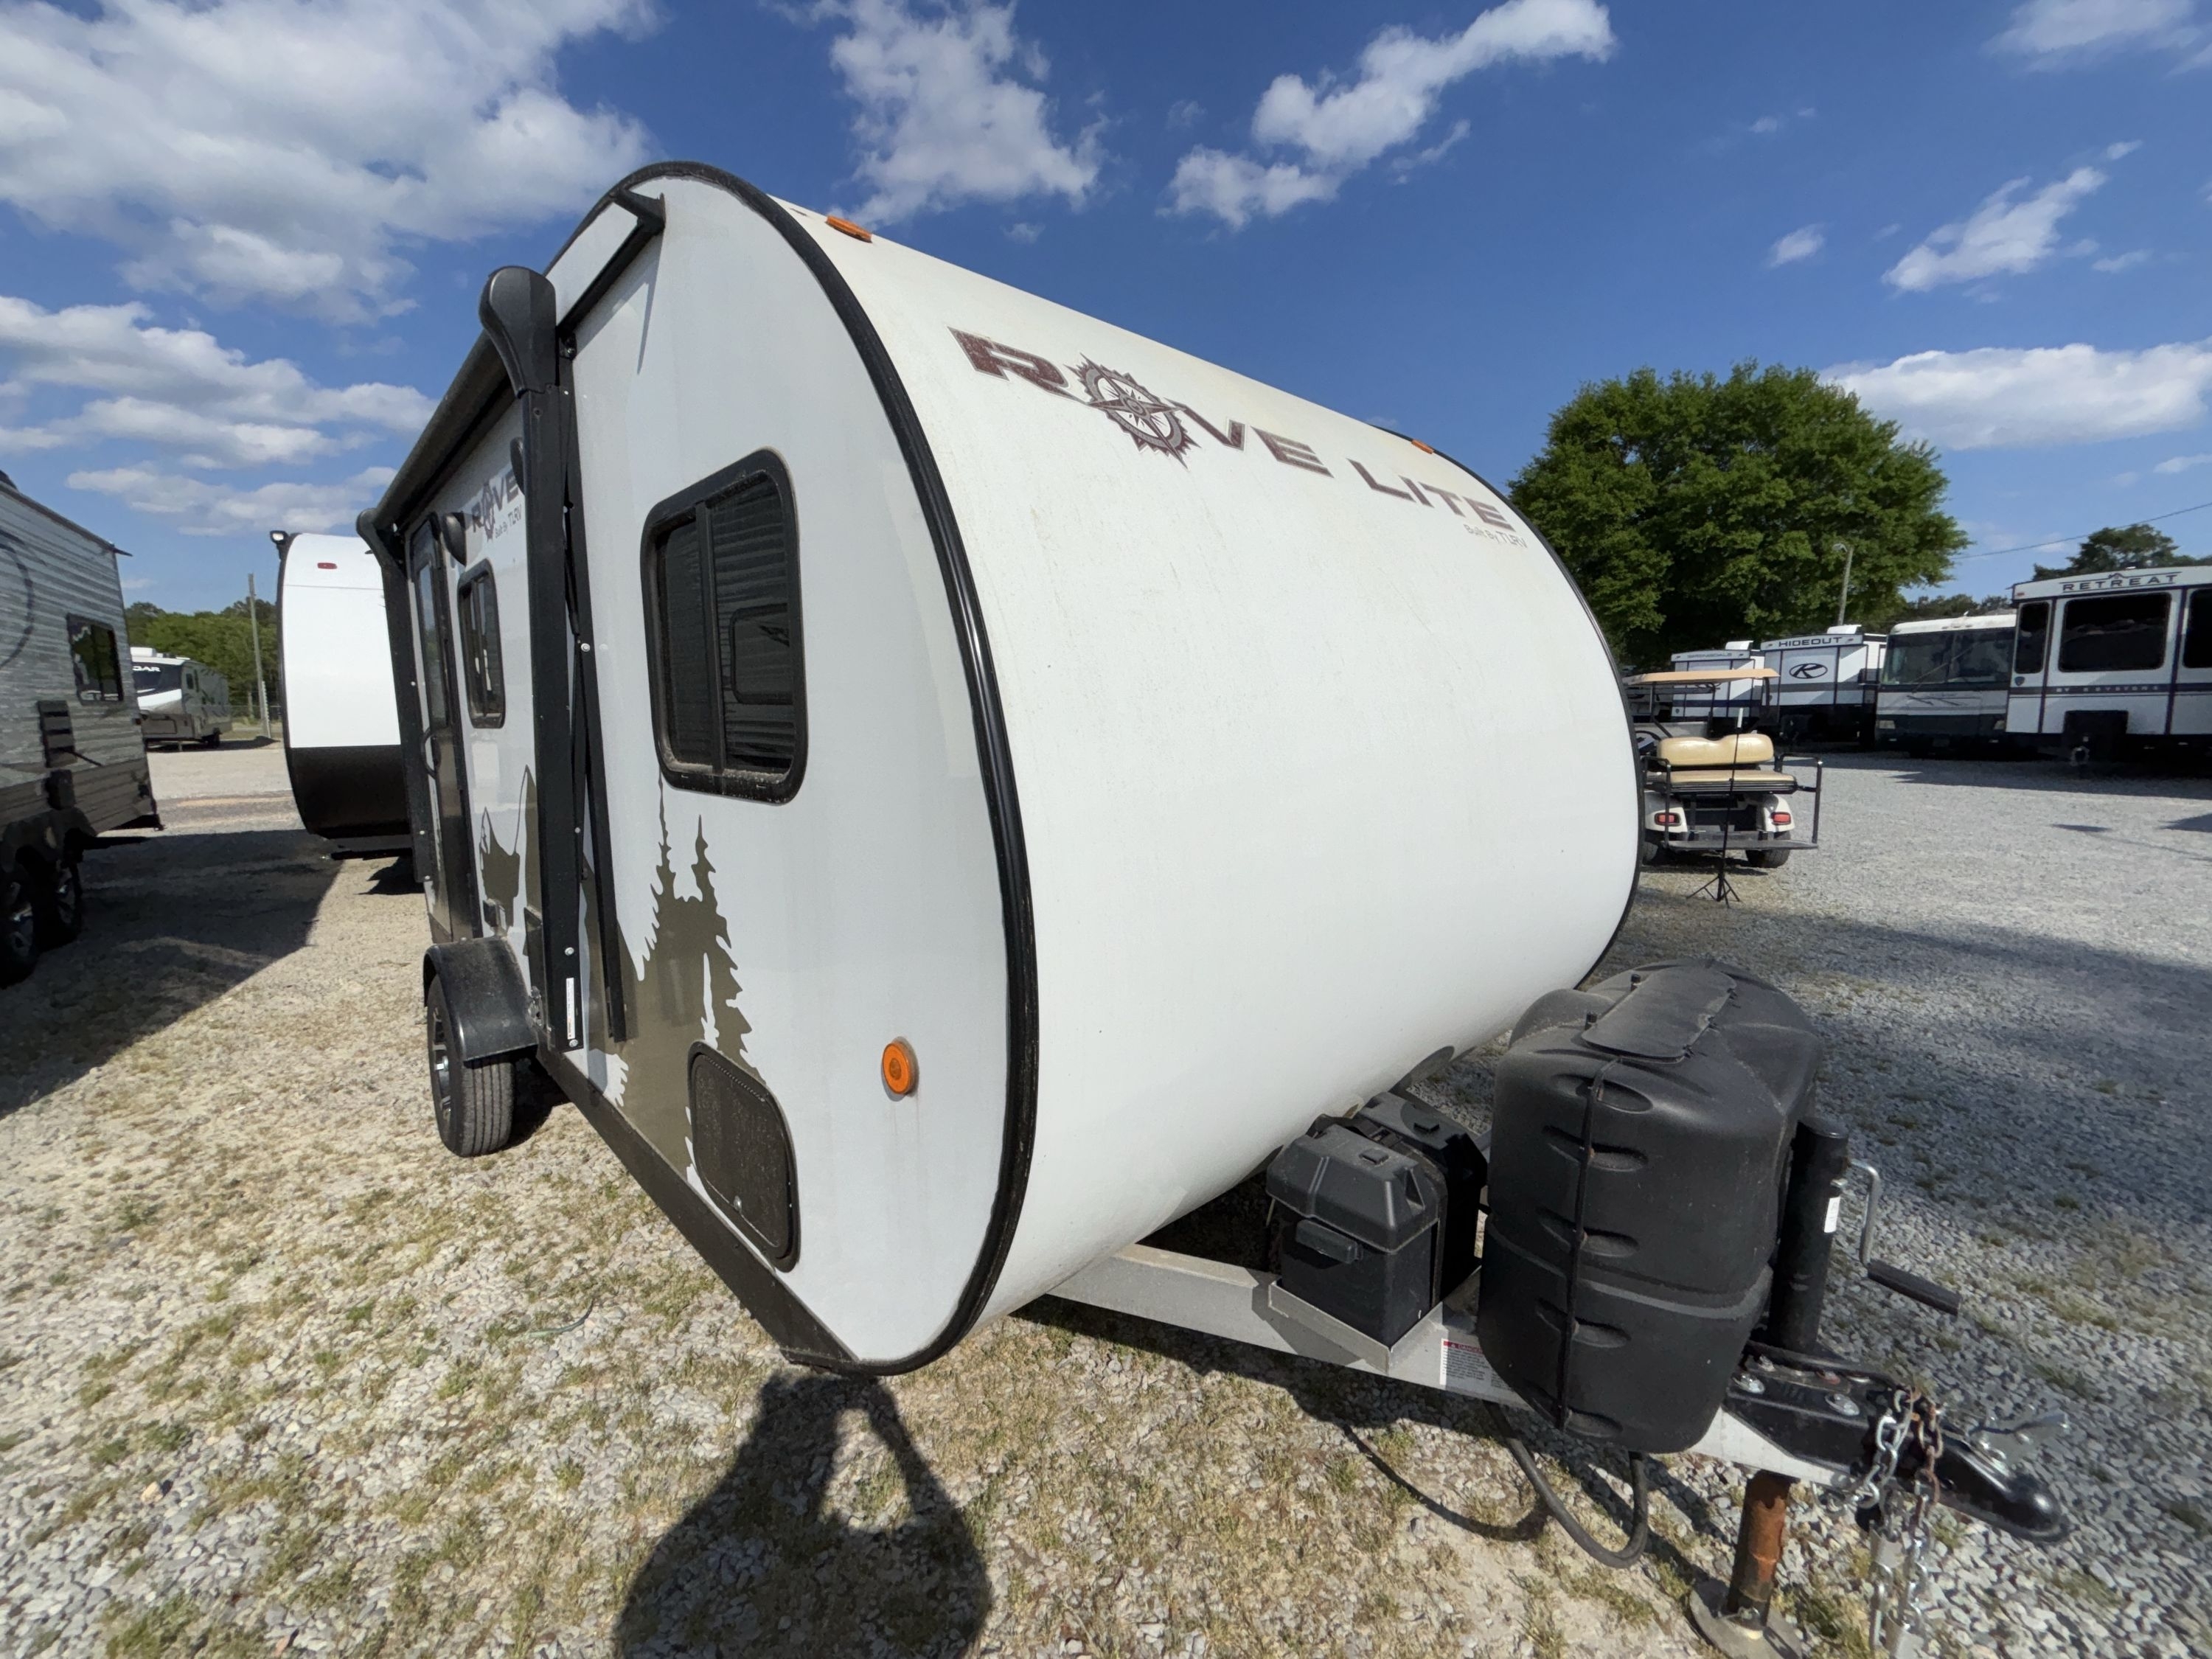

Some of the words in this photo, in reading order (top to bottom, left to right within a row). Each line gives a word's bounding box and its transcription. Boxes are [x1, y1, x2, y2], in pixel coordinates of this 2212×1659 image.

[1346, 458, 1516, 532] LITE
[1495, 531, 1528, 548] TLRV
[2062, 574, 2177, 591] RETREAT
[1778, 637, 1843, 647] HIDEOUT
